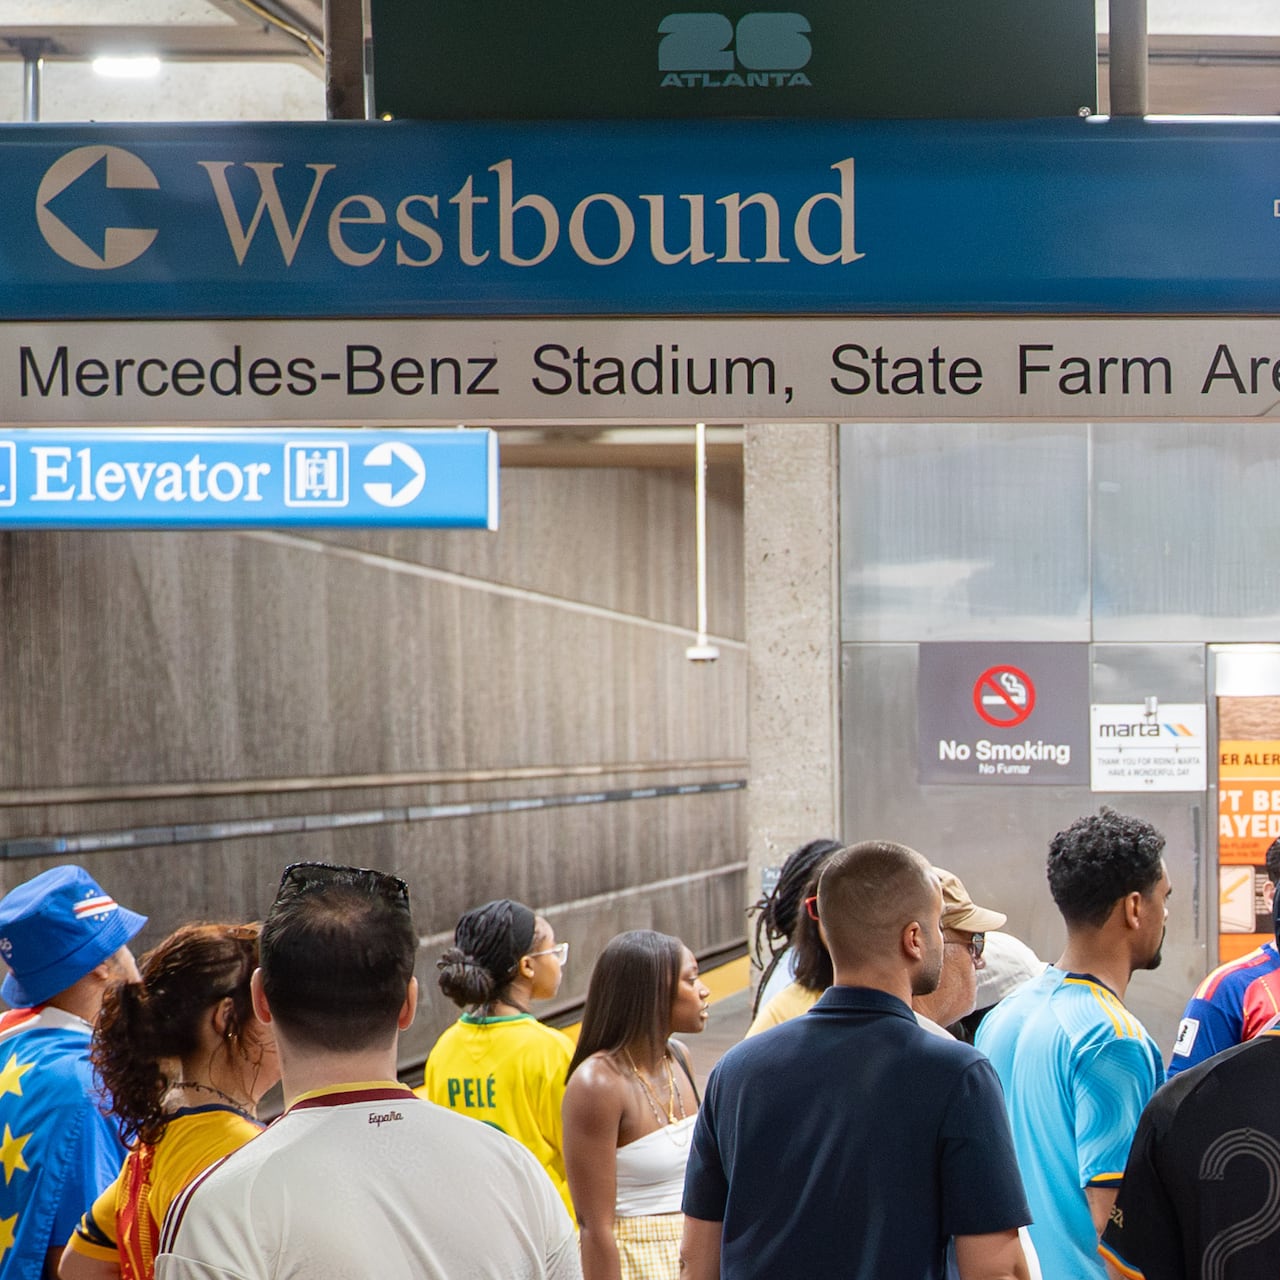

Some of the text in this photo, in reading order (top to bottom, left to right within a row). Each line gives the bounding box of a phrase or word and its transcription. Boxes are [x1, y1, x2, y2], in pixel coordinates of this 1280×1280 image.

[657, 12, 812, 71] 26
[660, 72, 812, 87] ATLANTA
[199, 158, 865, 268] Westbound
[19, 345, 499, 396] Mercedes-Benz
[532, 343, 795, 402] Stadium,
[830, 343, 983, 396] State
[1019, 344, 1172, 395] Farm
[30, 448, 269, 503] Elevator
[1099, 723, 1160, 737] marta
[939, 739, 1071, 765] No Smoking
[1221, 753, 1239, 766] ER
[979, 763, 1031, 775] No Fumar
[1219, 790, 1243, 812] 'T
[447, 1073, 497, 1108] PELÉ
[368, 1110, 404, 1127] España
